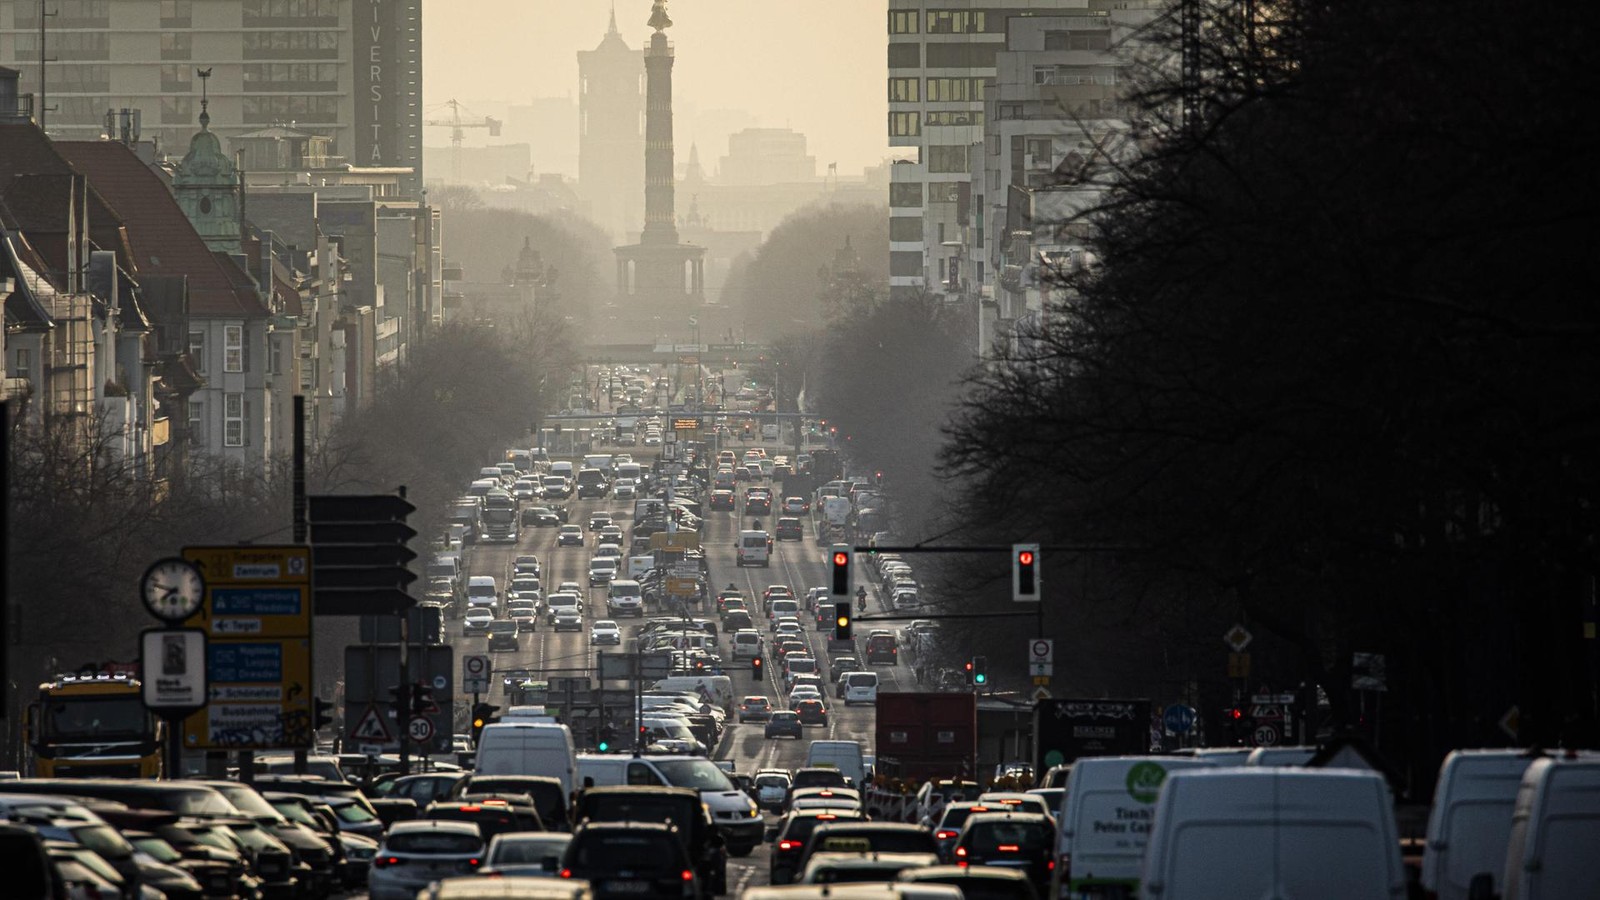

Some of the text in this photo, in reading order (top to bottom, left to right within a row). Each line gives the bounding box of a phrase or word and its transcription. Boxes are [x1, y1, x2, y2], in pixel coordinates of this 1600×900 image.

[371, 0, 383, 165] IVERSITÄ
[689, 314, 697, 325] S
[236, 566, 279, 575] Zentrum
[233, 620, 259, 631] Tegel
[226, 686, 280, 698] Schönefeld
[412, 722, 428, 736] 30
[1257, 729, 1273, 743] 30
[1093, 820, 1126, 833] Peter
